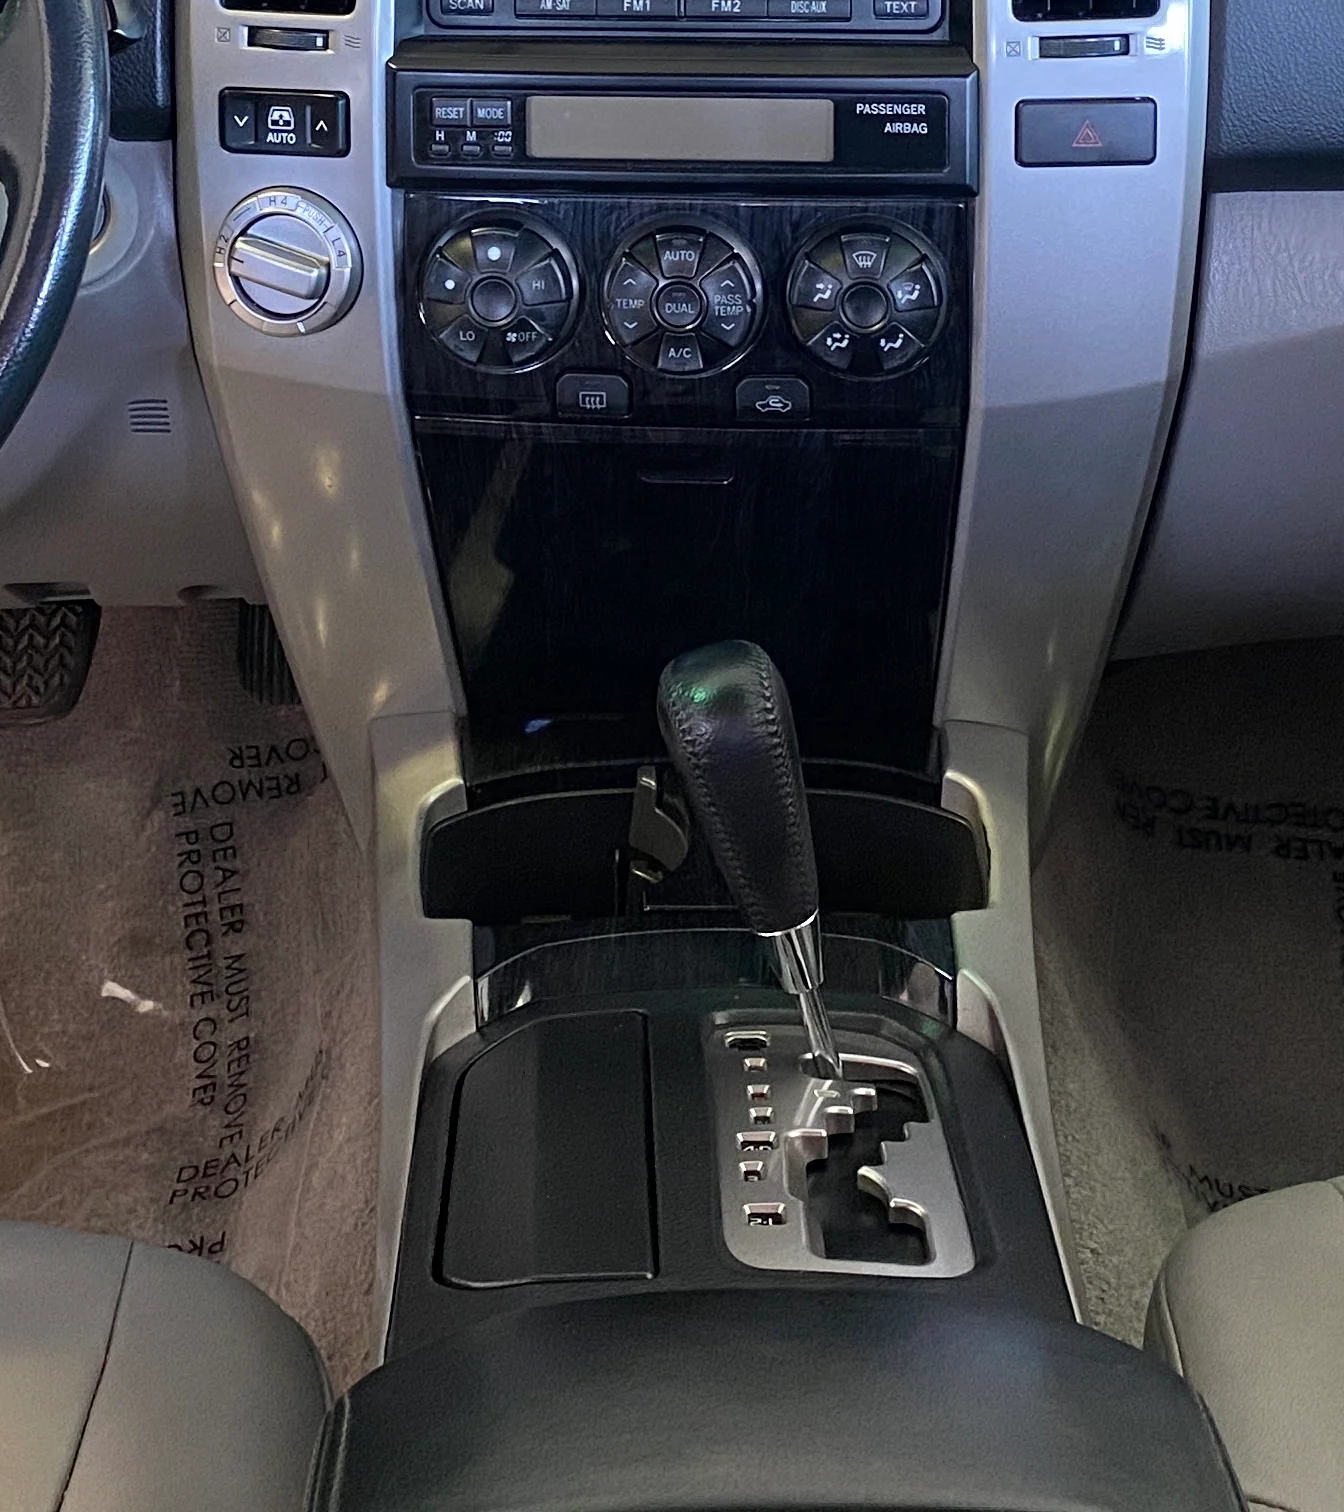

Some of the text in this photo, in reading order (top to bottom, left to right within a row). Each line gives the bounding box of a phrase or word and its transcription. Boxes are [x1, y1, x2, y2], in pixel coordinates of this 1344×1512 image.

[623, 0, 651, 12] FM1
[711, 0, 741, 12] FM2
[884, 1, 917, 14] TEXT
[435, 106, 505, 120] RESET MODE
[855, 103, 927, 116] PASSENGER
[884, 122, 929, 135] AIRBAG
[266, 132, 297, 145] AUTO
[435, 131, 444, 141] H
[466, 131, 477, 141] M
[663, 250, 696, 261] AUTO
[532, 279, 545, 291] HI
[616, 298, 646, 310] TEMP
[714, 294, 743, 305] PASS
[664, 302, 695, 314] DUAL
[714, 305, 744, 317] TEMP
[459, 330, 475, 342] LO
[517, 331, 538, 342] OFF
[668, 347, 692, 359] A/C
[225, 737, 320, 769] OVER
[170, 772, 303, 818] REMOVE
[174, 828, 219, 1112] PROTECTIVE COVER
[209, 821, 251, 1150] DEALER MUST REMOVE
